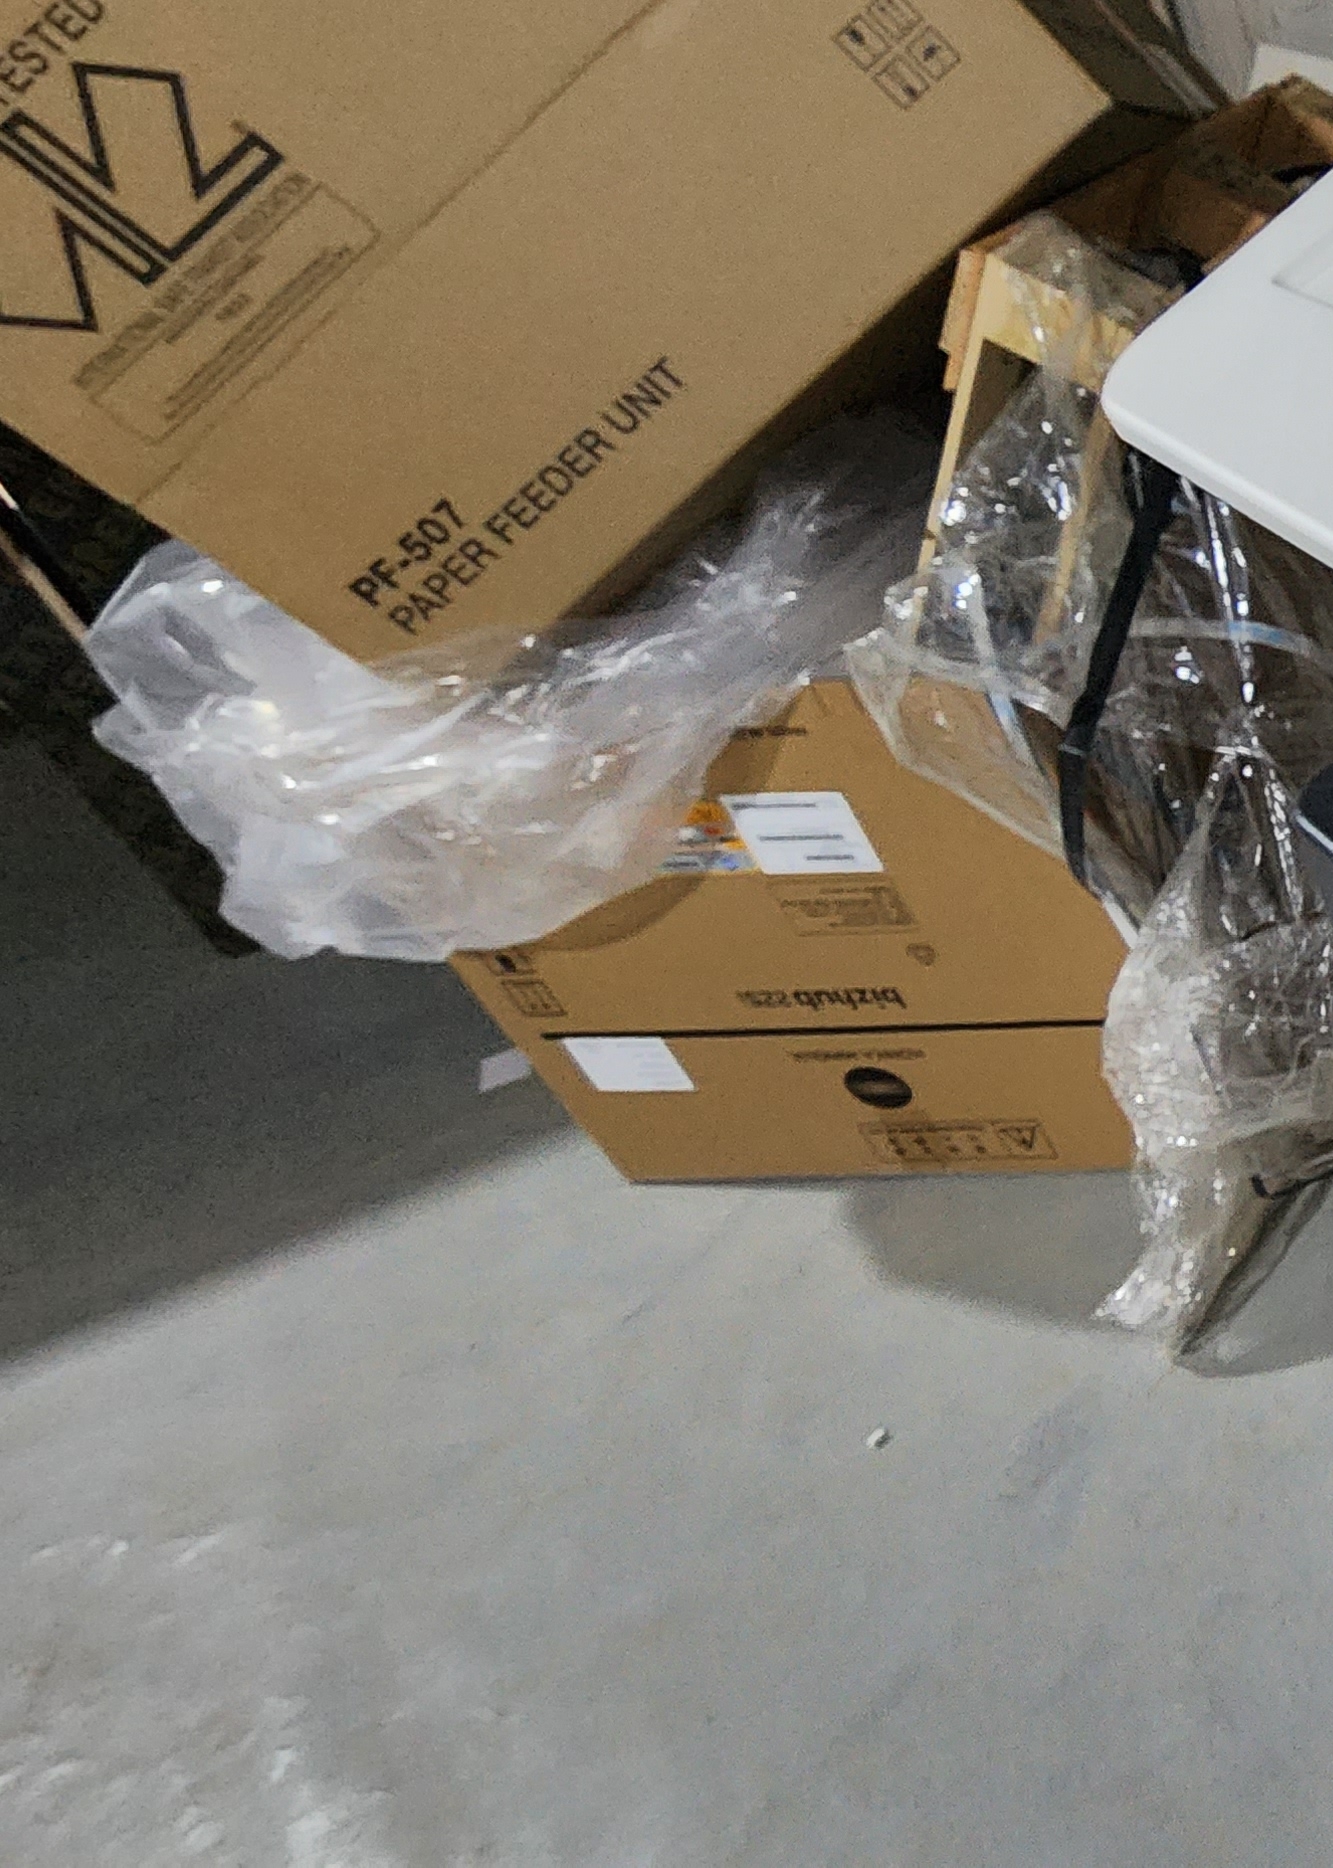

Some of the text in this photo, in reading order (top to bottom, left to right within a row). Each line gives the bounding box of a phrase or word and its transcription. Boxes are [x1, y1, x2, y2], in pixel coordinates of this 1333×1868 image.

[0, 0, 103, 106] ESTED
[388, 356, 687, 636] PAPER FEEDER UNIT
[348, 499, 468, 609] PF-507
